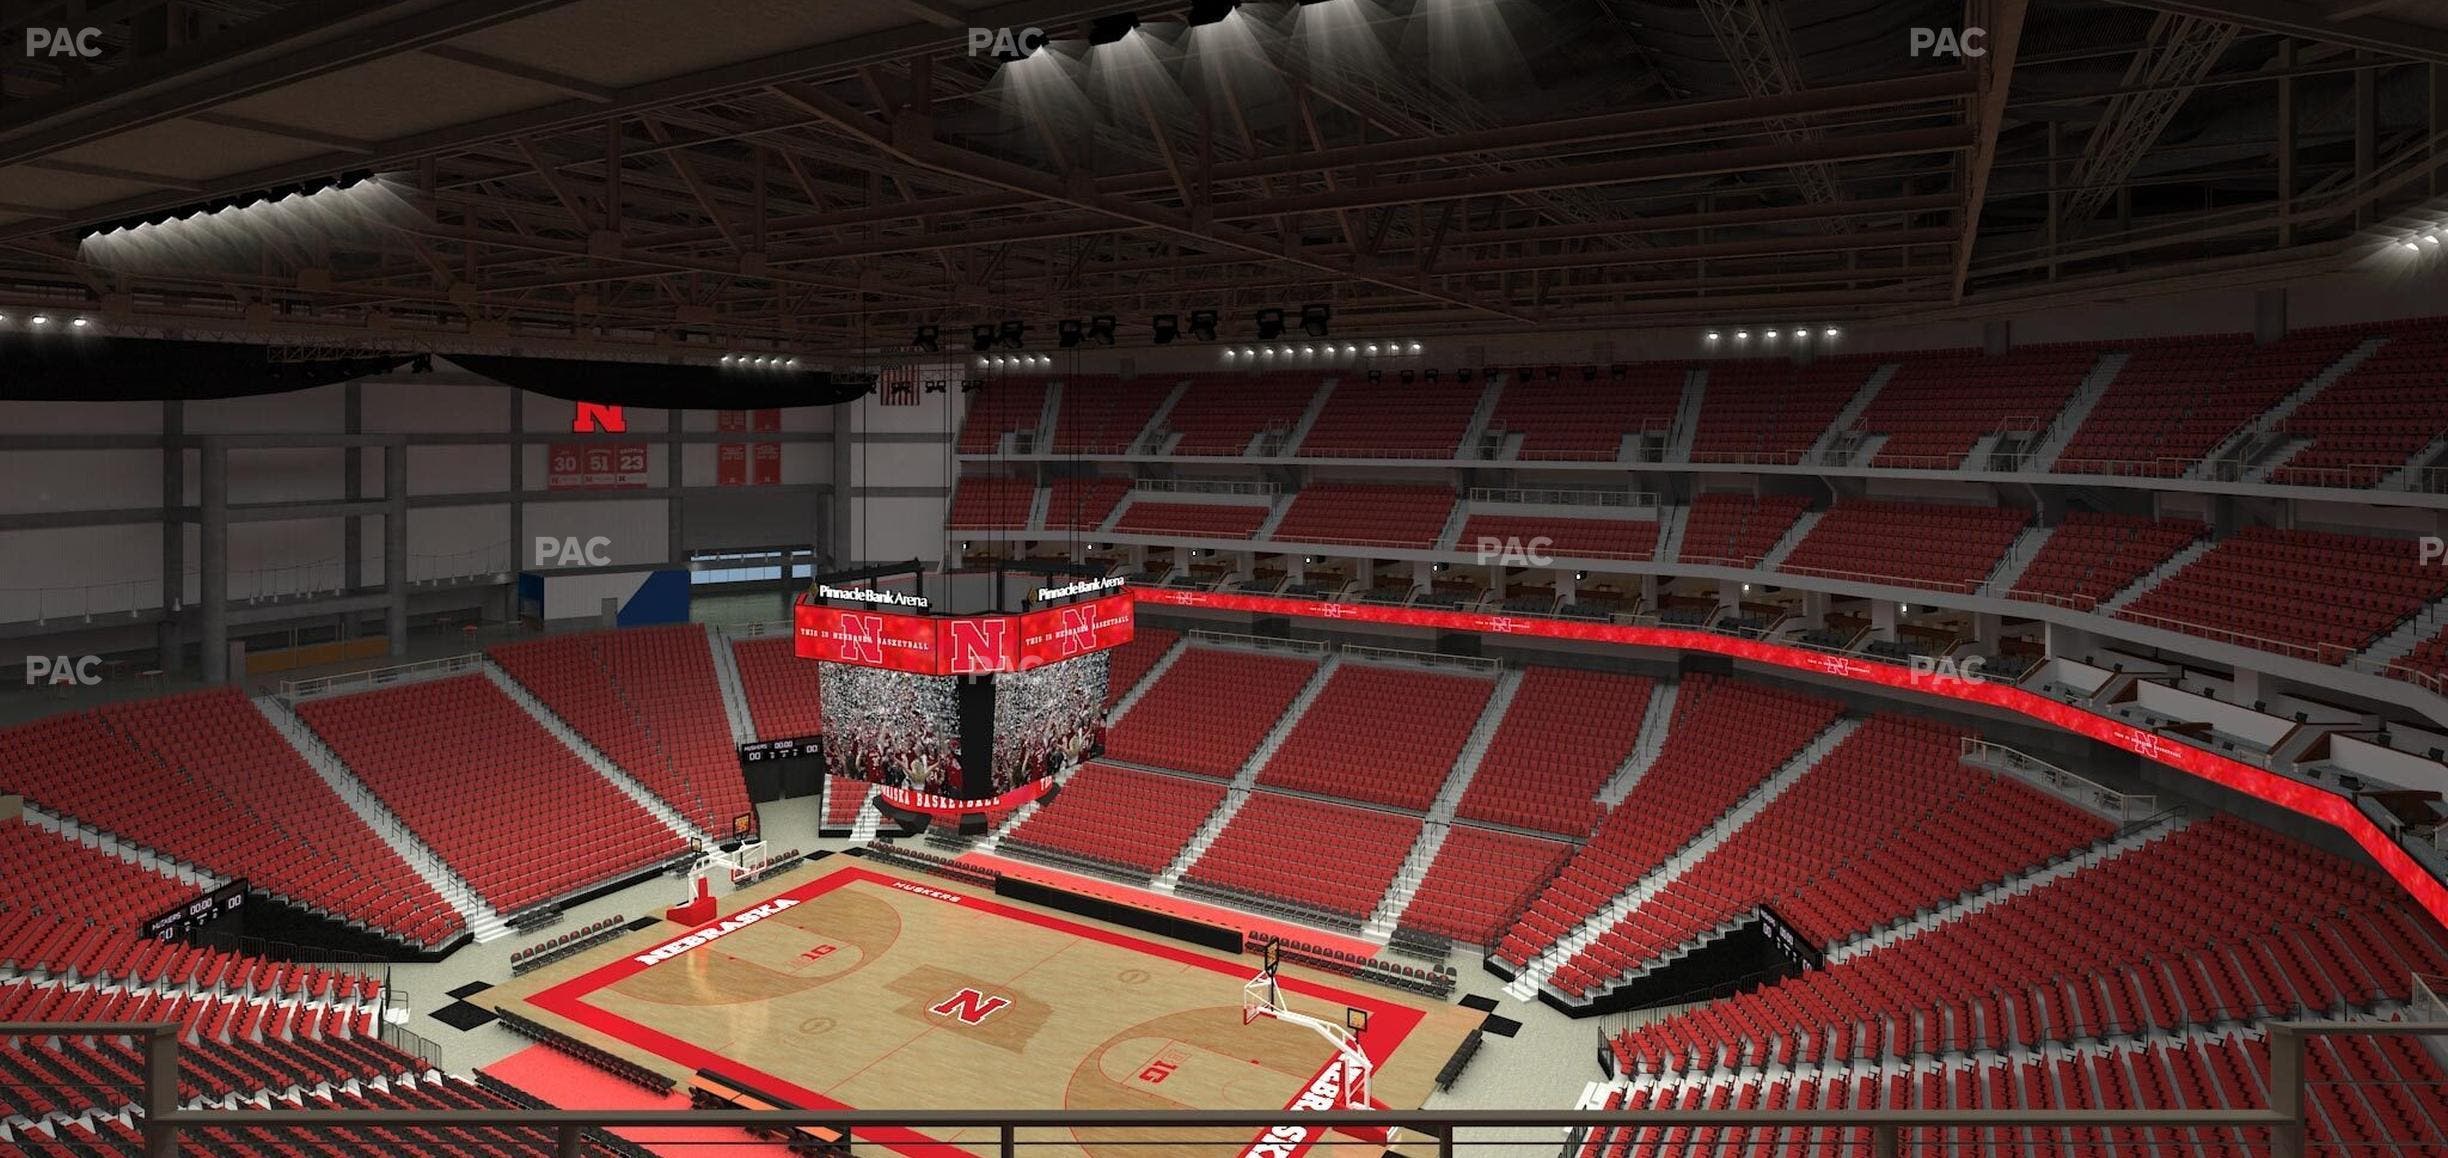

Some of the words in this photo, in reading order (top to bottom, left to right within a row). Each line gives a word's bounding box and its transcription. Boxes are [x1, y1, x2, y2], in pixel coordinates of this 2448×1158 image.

[573, 401, 627, 433] N
[620, 455, 644, 471] 23
[1100, 577, 1124, 589] Arena
[894, 592, 928, 607] Arena
[951, 619, 1006, 673] N
[228, 894, 242, 910] 00
[893, 881, 961, 903] HUSKERS
[633, 898, 801, 966] NEBRASKA
[929, 987, 1009, 1026] N
